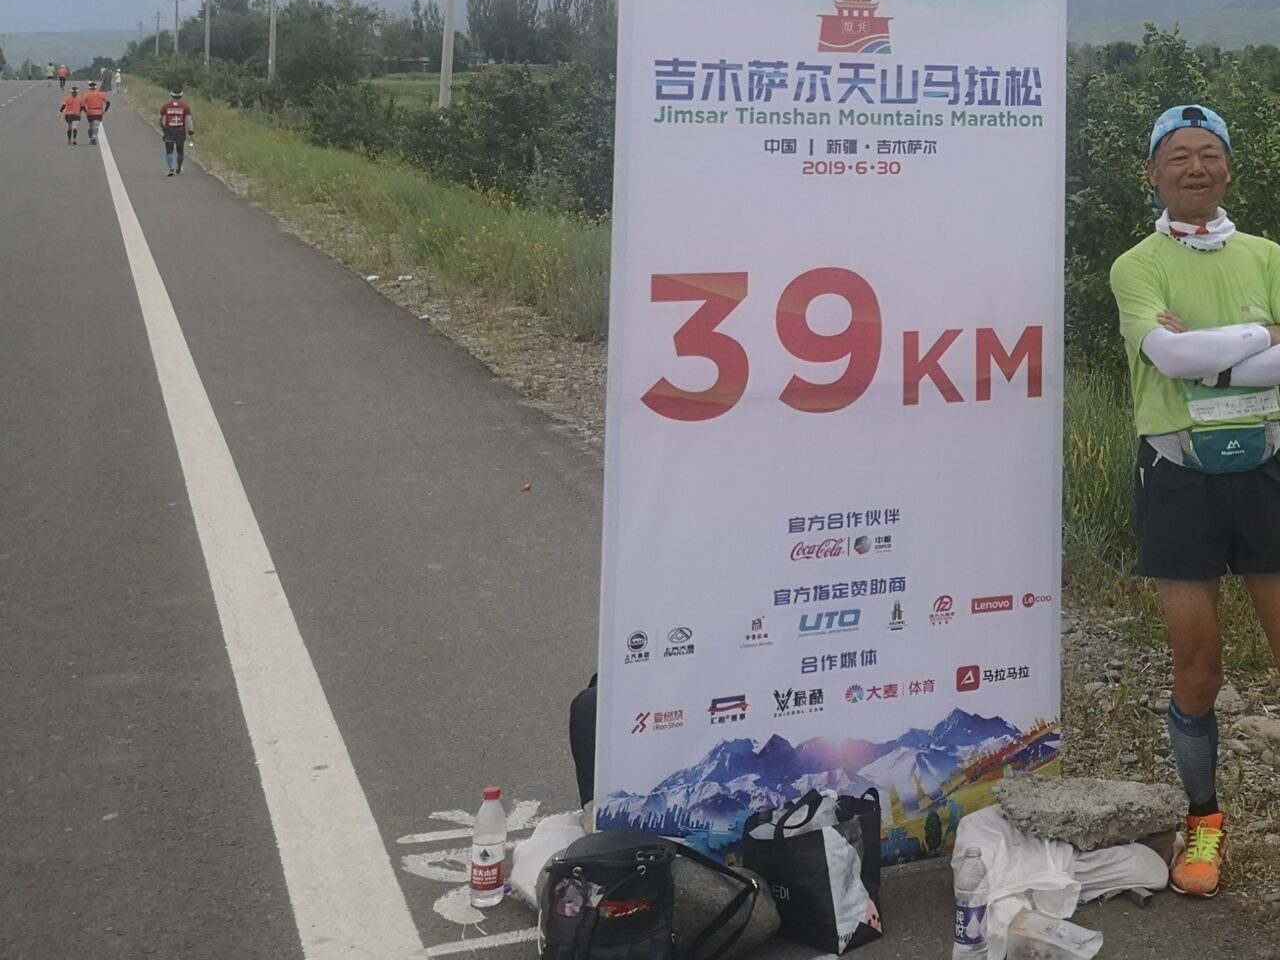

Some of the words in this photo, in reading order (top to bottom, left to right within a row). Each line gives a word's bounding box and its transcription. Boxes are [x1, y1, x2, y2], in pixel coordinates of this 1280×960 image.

[654, 57, 1042, 107] 吉木萨尔天山马拉松
[653, 106, 729, 125] Jimsar
[736, 108, 831, 127] Tianshan
[839, 109, 944, 128] Mountains
[951, 110, 1044, 128] Marathon
[764, 138, 797, 154] 中国
[788, 508, 901, 534] 官方合作伙伴
[773, 576, 907, 606] 官方指定赞助商
[974, 599, 1010, 610] Lenovo
[798, 608, 862, 632] UTO
[801, 649, 878, 674] 合作媒体
[982, 666, 1030, 682] 马拉马拉
[793, 689, 824, 707] 最酷
[866, 684, 899, 701] 大麦
[908, 679, 936, 696] 体育
[653, 709, 684, 723] 爱燃烧
